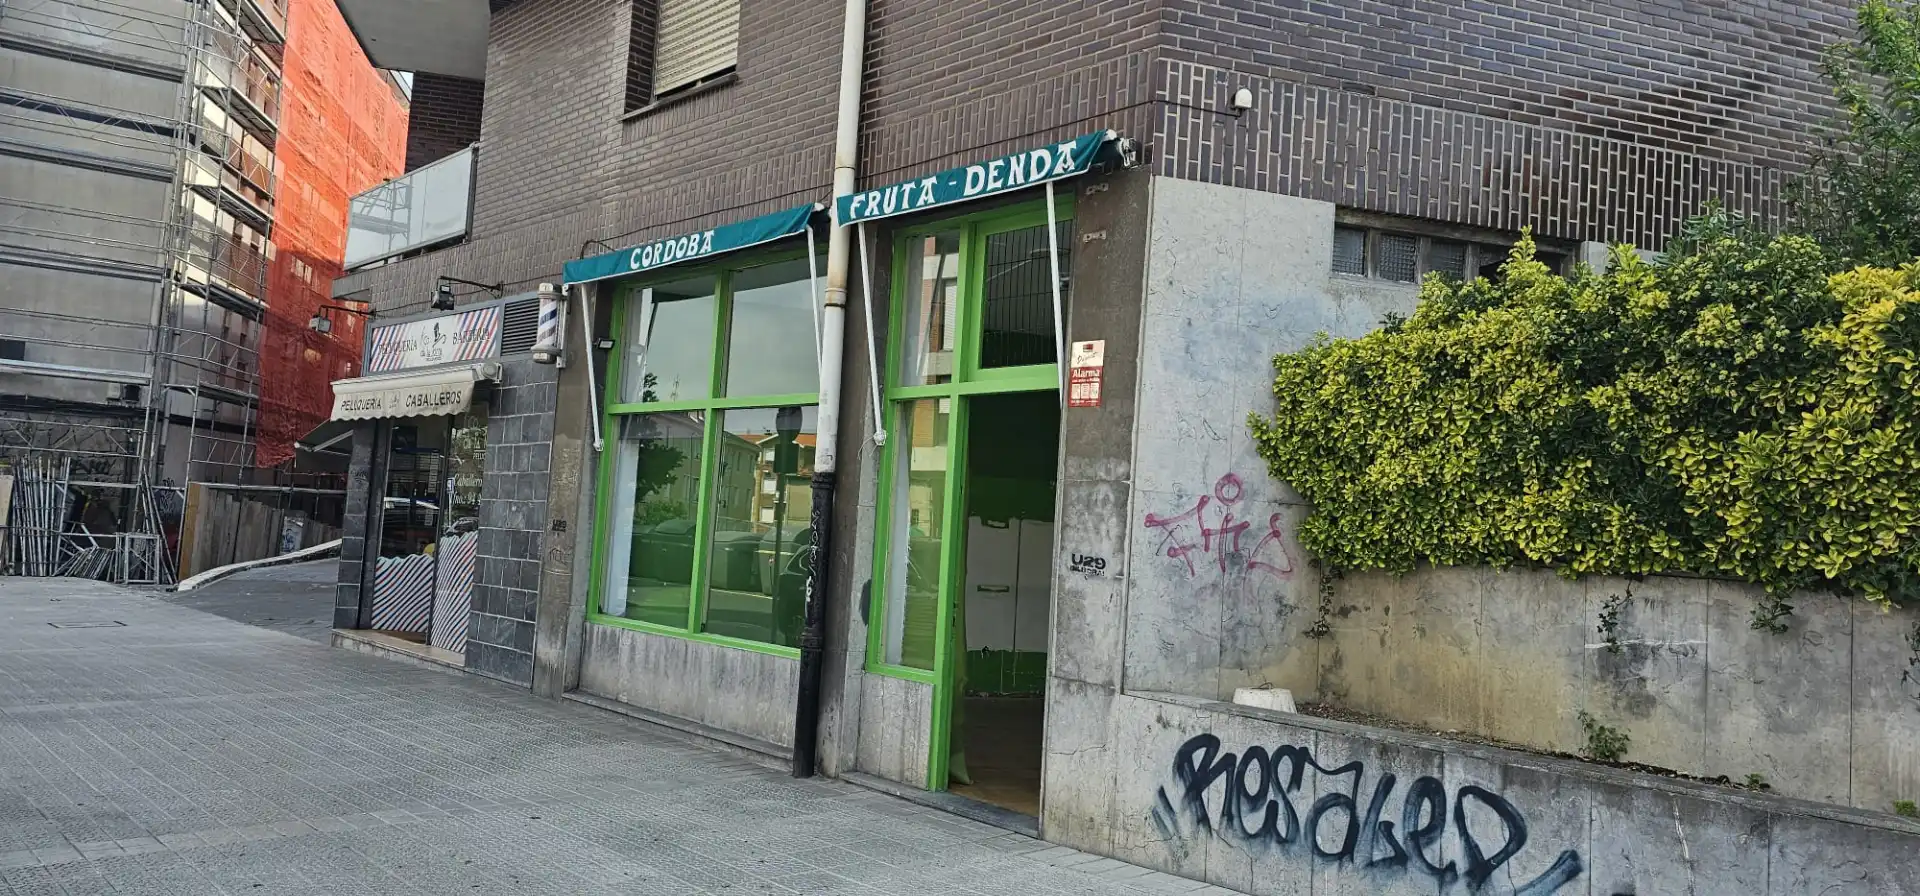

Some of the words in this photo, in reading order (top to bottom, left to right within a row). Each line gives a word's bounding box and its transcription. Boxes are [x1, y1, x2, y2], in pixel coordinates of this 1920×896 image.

[850, 175, 938, 220] FRUTA
[963, 140, 1077, 196] DENDA
[630, 229, 715, 270] CORDOBA
[1072, 368, 1100, 378] Alarma
[405, 391, 462, 408] CABALLEROS
[1071, 553, 1106, 570] U29
